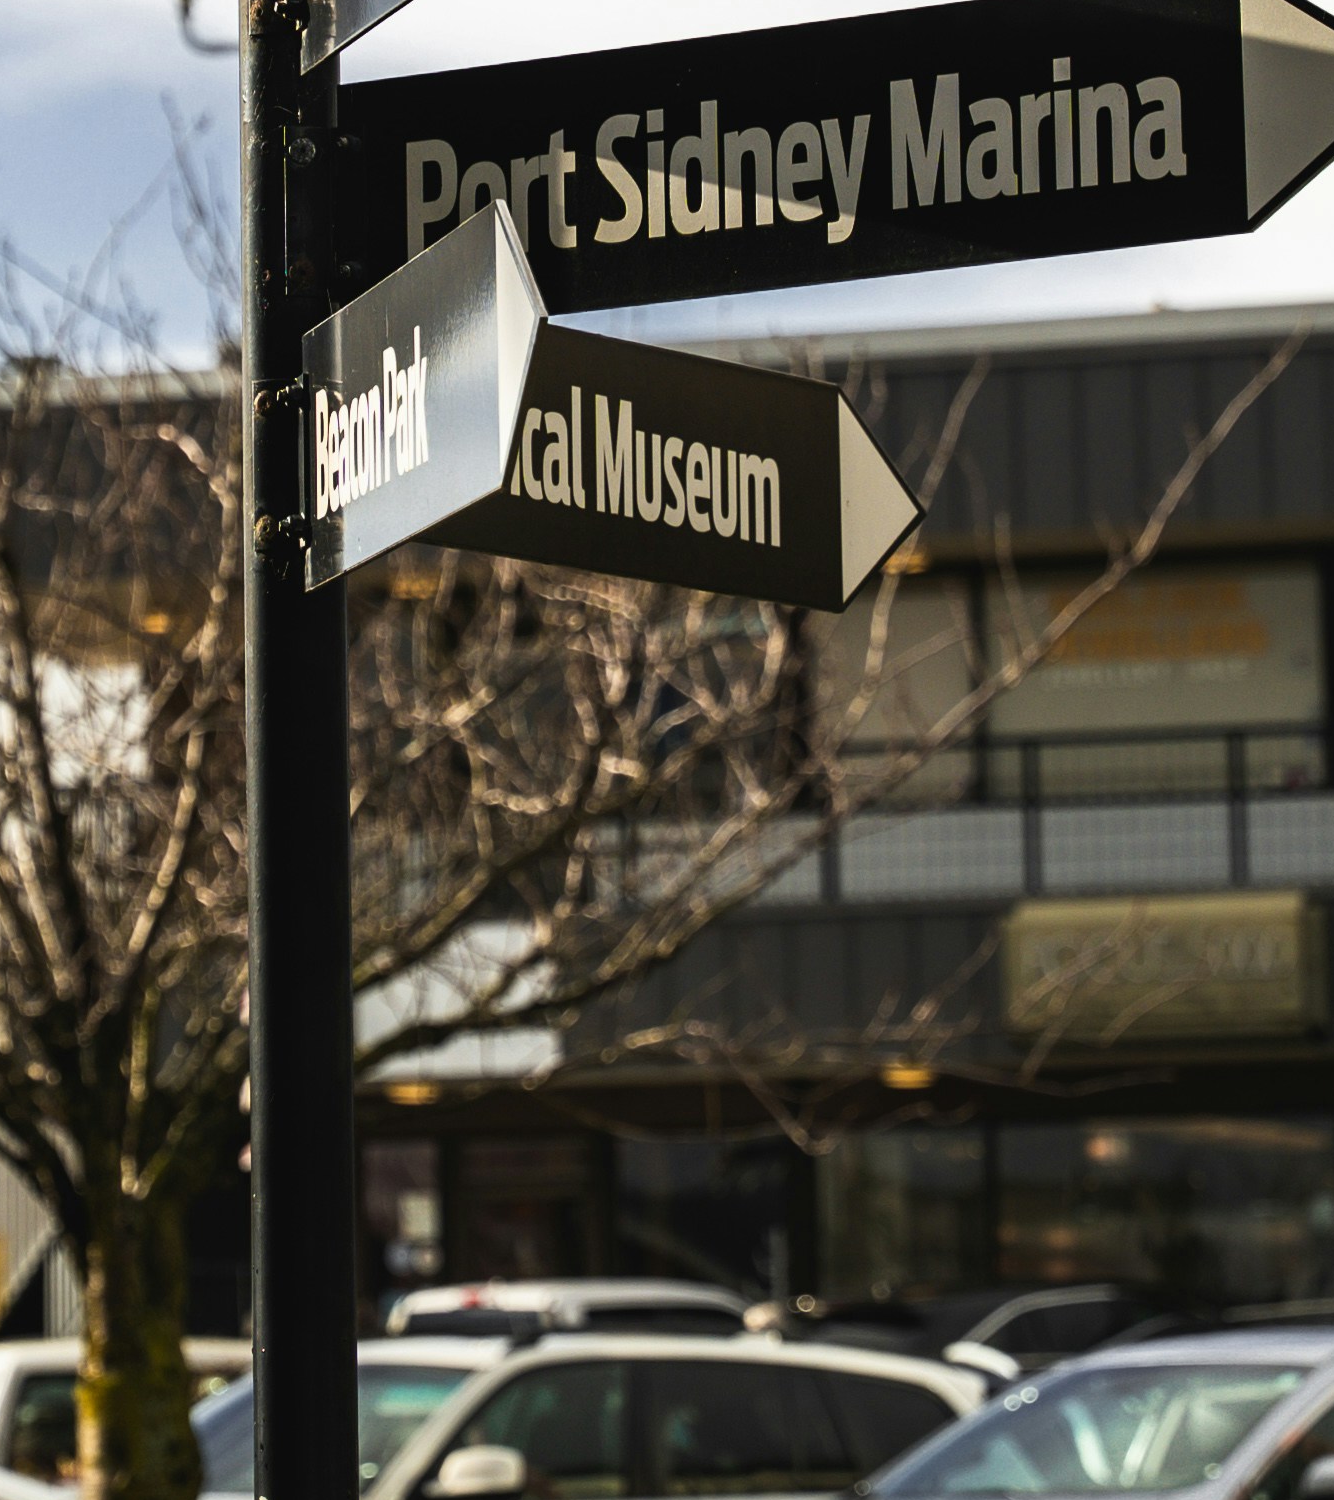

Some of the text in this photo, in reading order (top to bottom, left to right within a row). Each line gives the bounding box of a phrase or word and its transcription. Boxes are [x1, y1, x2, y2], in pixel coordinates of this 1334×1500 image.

[406, 56, 1188, 260] Port Sidney Marina
[315, 386, 382, 521] Beacon
[382, 325, 429, 483] Park
[594, 393, 782, 548] Museum
